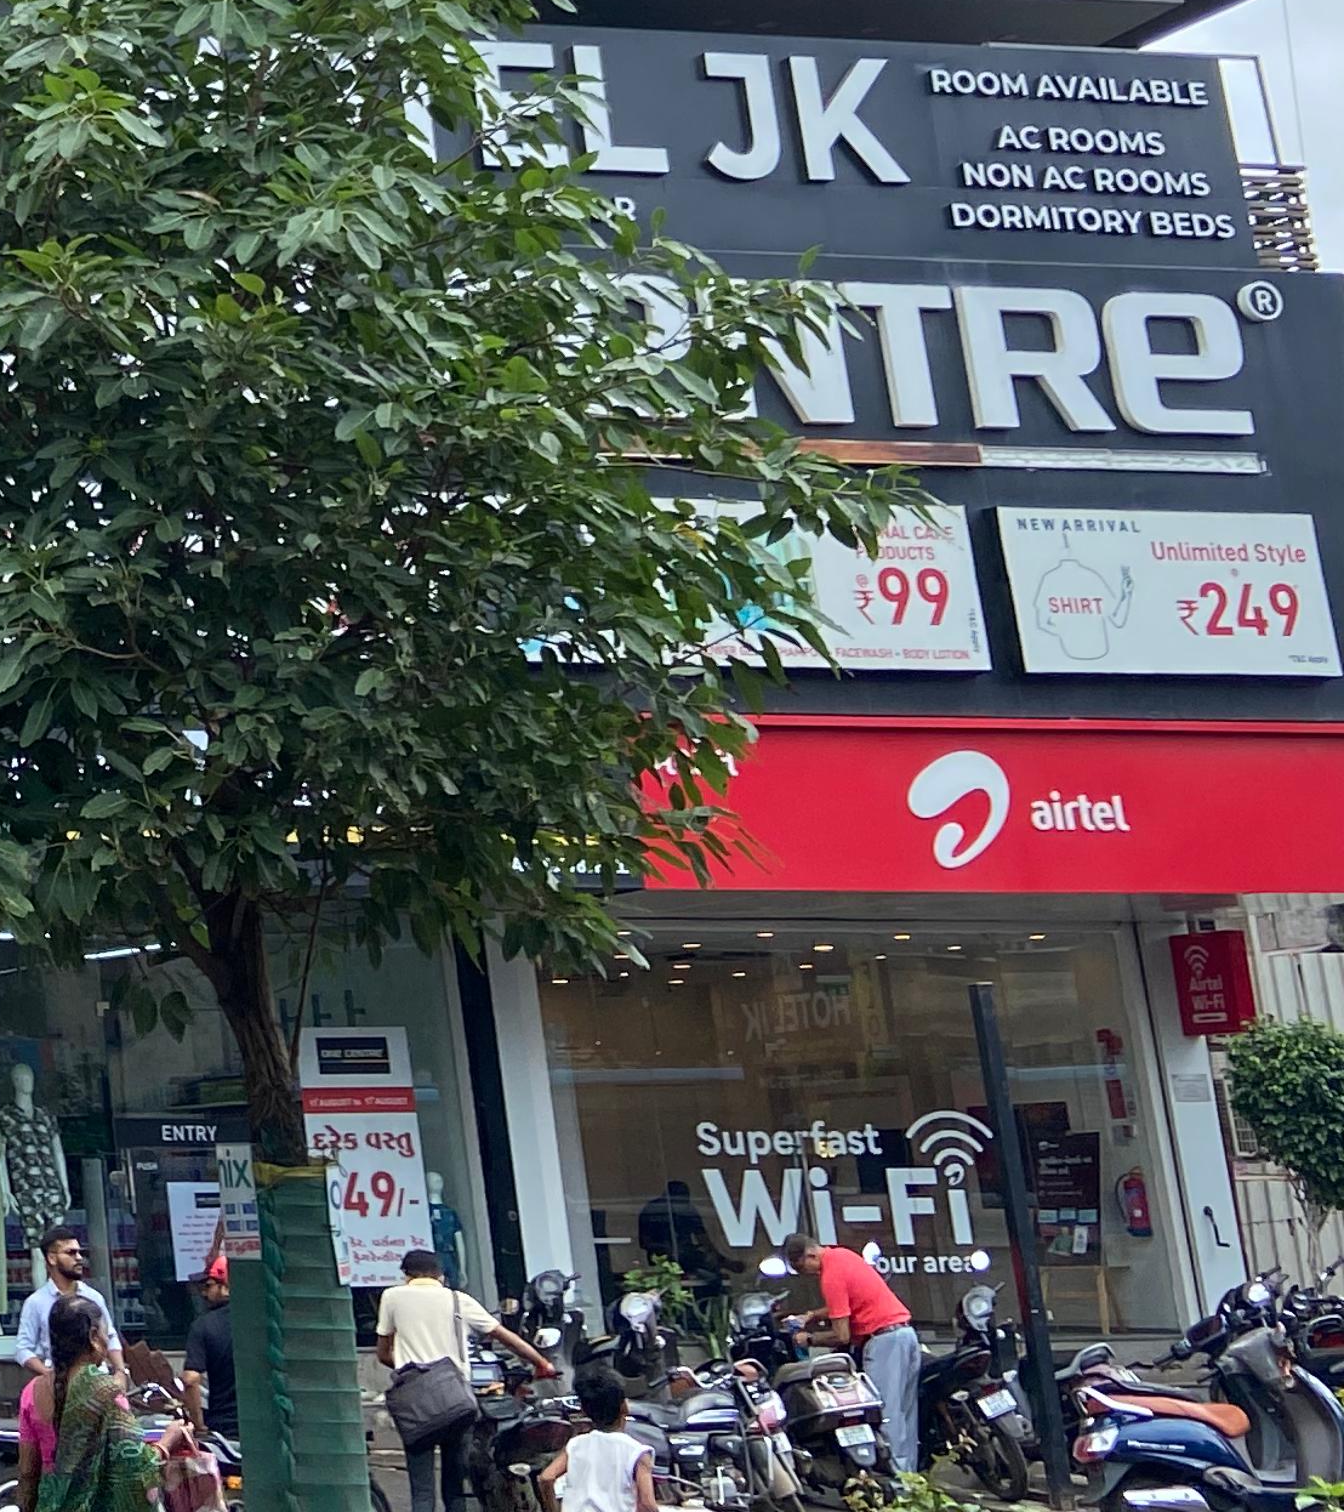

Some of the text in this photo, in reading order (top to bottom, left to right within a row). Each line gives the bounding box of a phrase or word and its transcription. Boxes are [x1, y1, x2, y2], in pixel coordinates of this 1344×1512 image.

[929, 68, 1209, 107] ROOM AVAILABLE
[699, 51, 912, 185] JK
[997, 125, 1166, 156] AC ROOMS
[962, 162, 1211, 197] NON AC ROOMS
[950, 202, 1237, 239] DORMITORY BEDS
[1016, 518, 1142, 533] NEW ARRIVAL
[1150, 540, 1307, 567] Unlimited Style
[1048, 596, 1104, 615] SHIRT
[835, 647, 971, 660] FACEWASH BODY LOTION
[1030, 790, 1131, 833] airtel
[161, 1124, 217, 1142] ENTRY
[313, 1124, 415, 1158] દરેક વસ્તુ
[695, 1119, 883, 1164] Superfast
[701, 1162, 974, 1248] Wi-Fi
[874, 1254, 917, 1274] our
